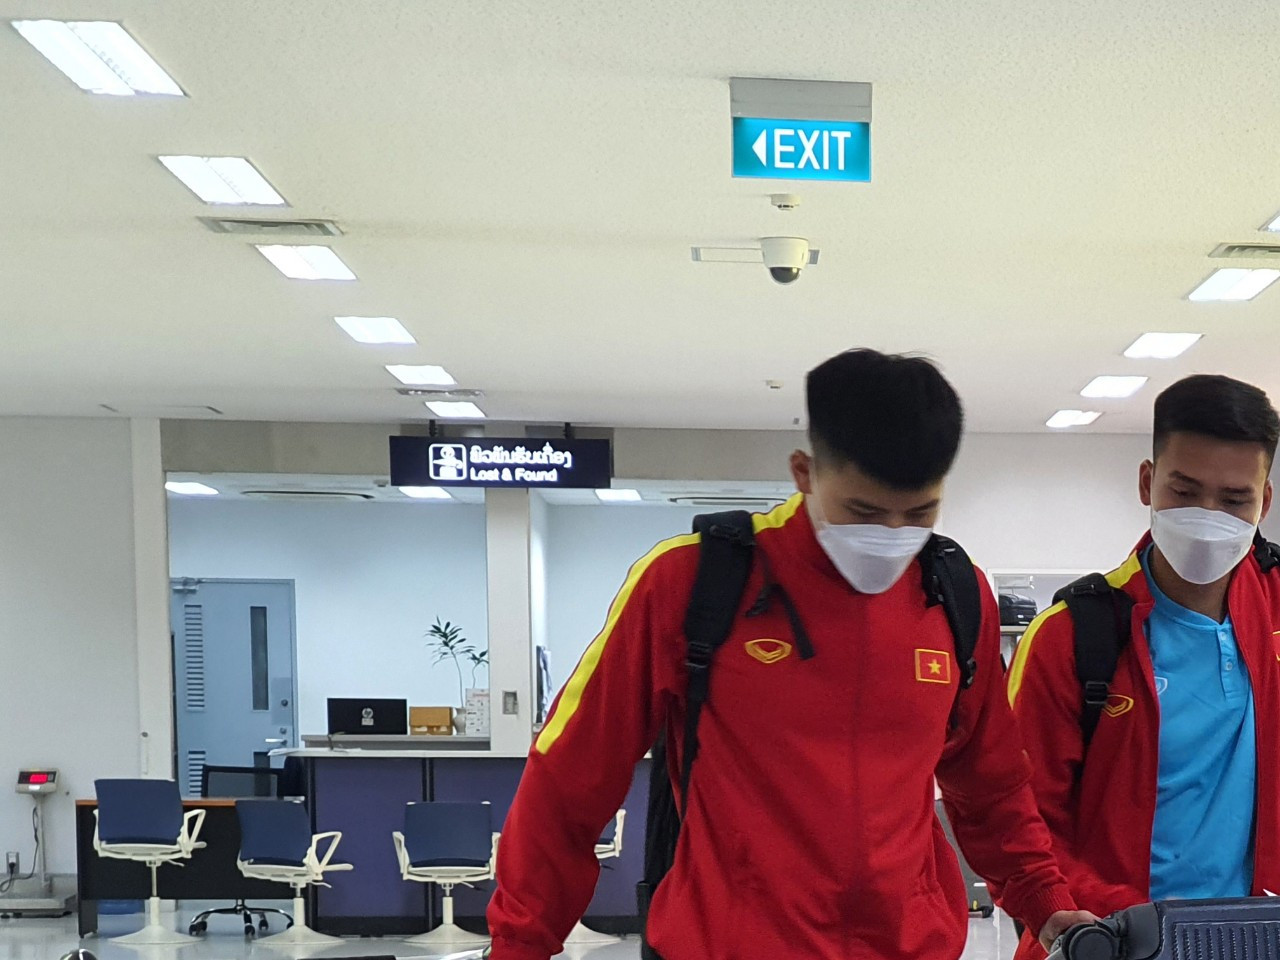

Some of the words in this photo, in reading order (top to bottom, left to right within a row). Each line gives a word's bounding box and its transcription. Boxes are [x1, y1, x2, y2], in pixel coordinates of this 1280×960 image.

[774, 128, 852, 171] EXIT
[469, 467, 500, 482] Lost
[501, 468, 513, 482] &
[514, 467, 558, 482] Found
